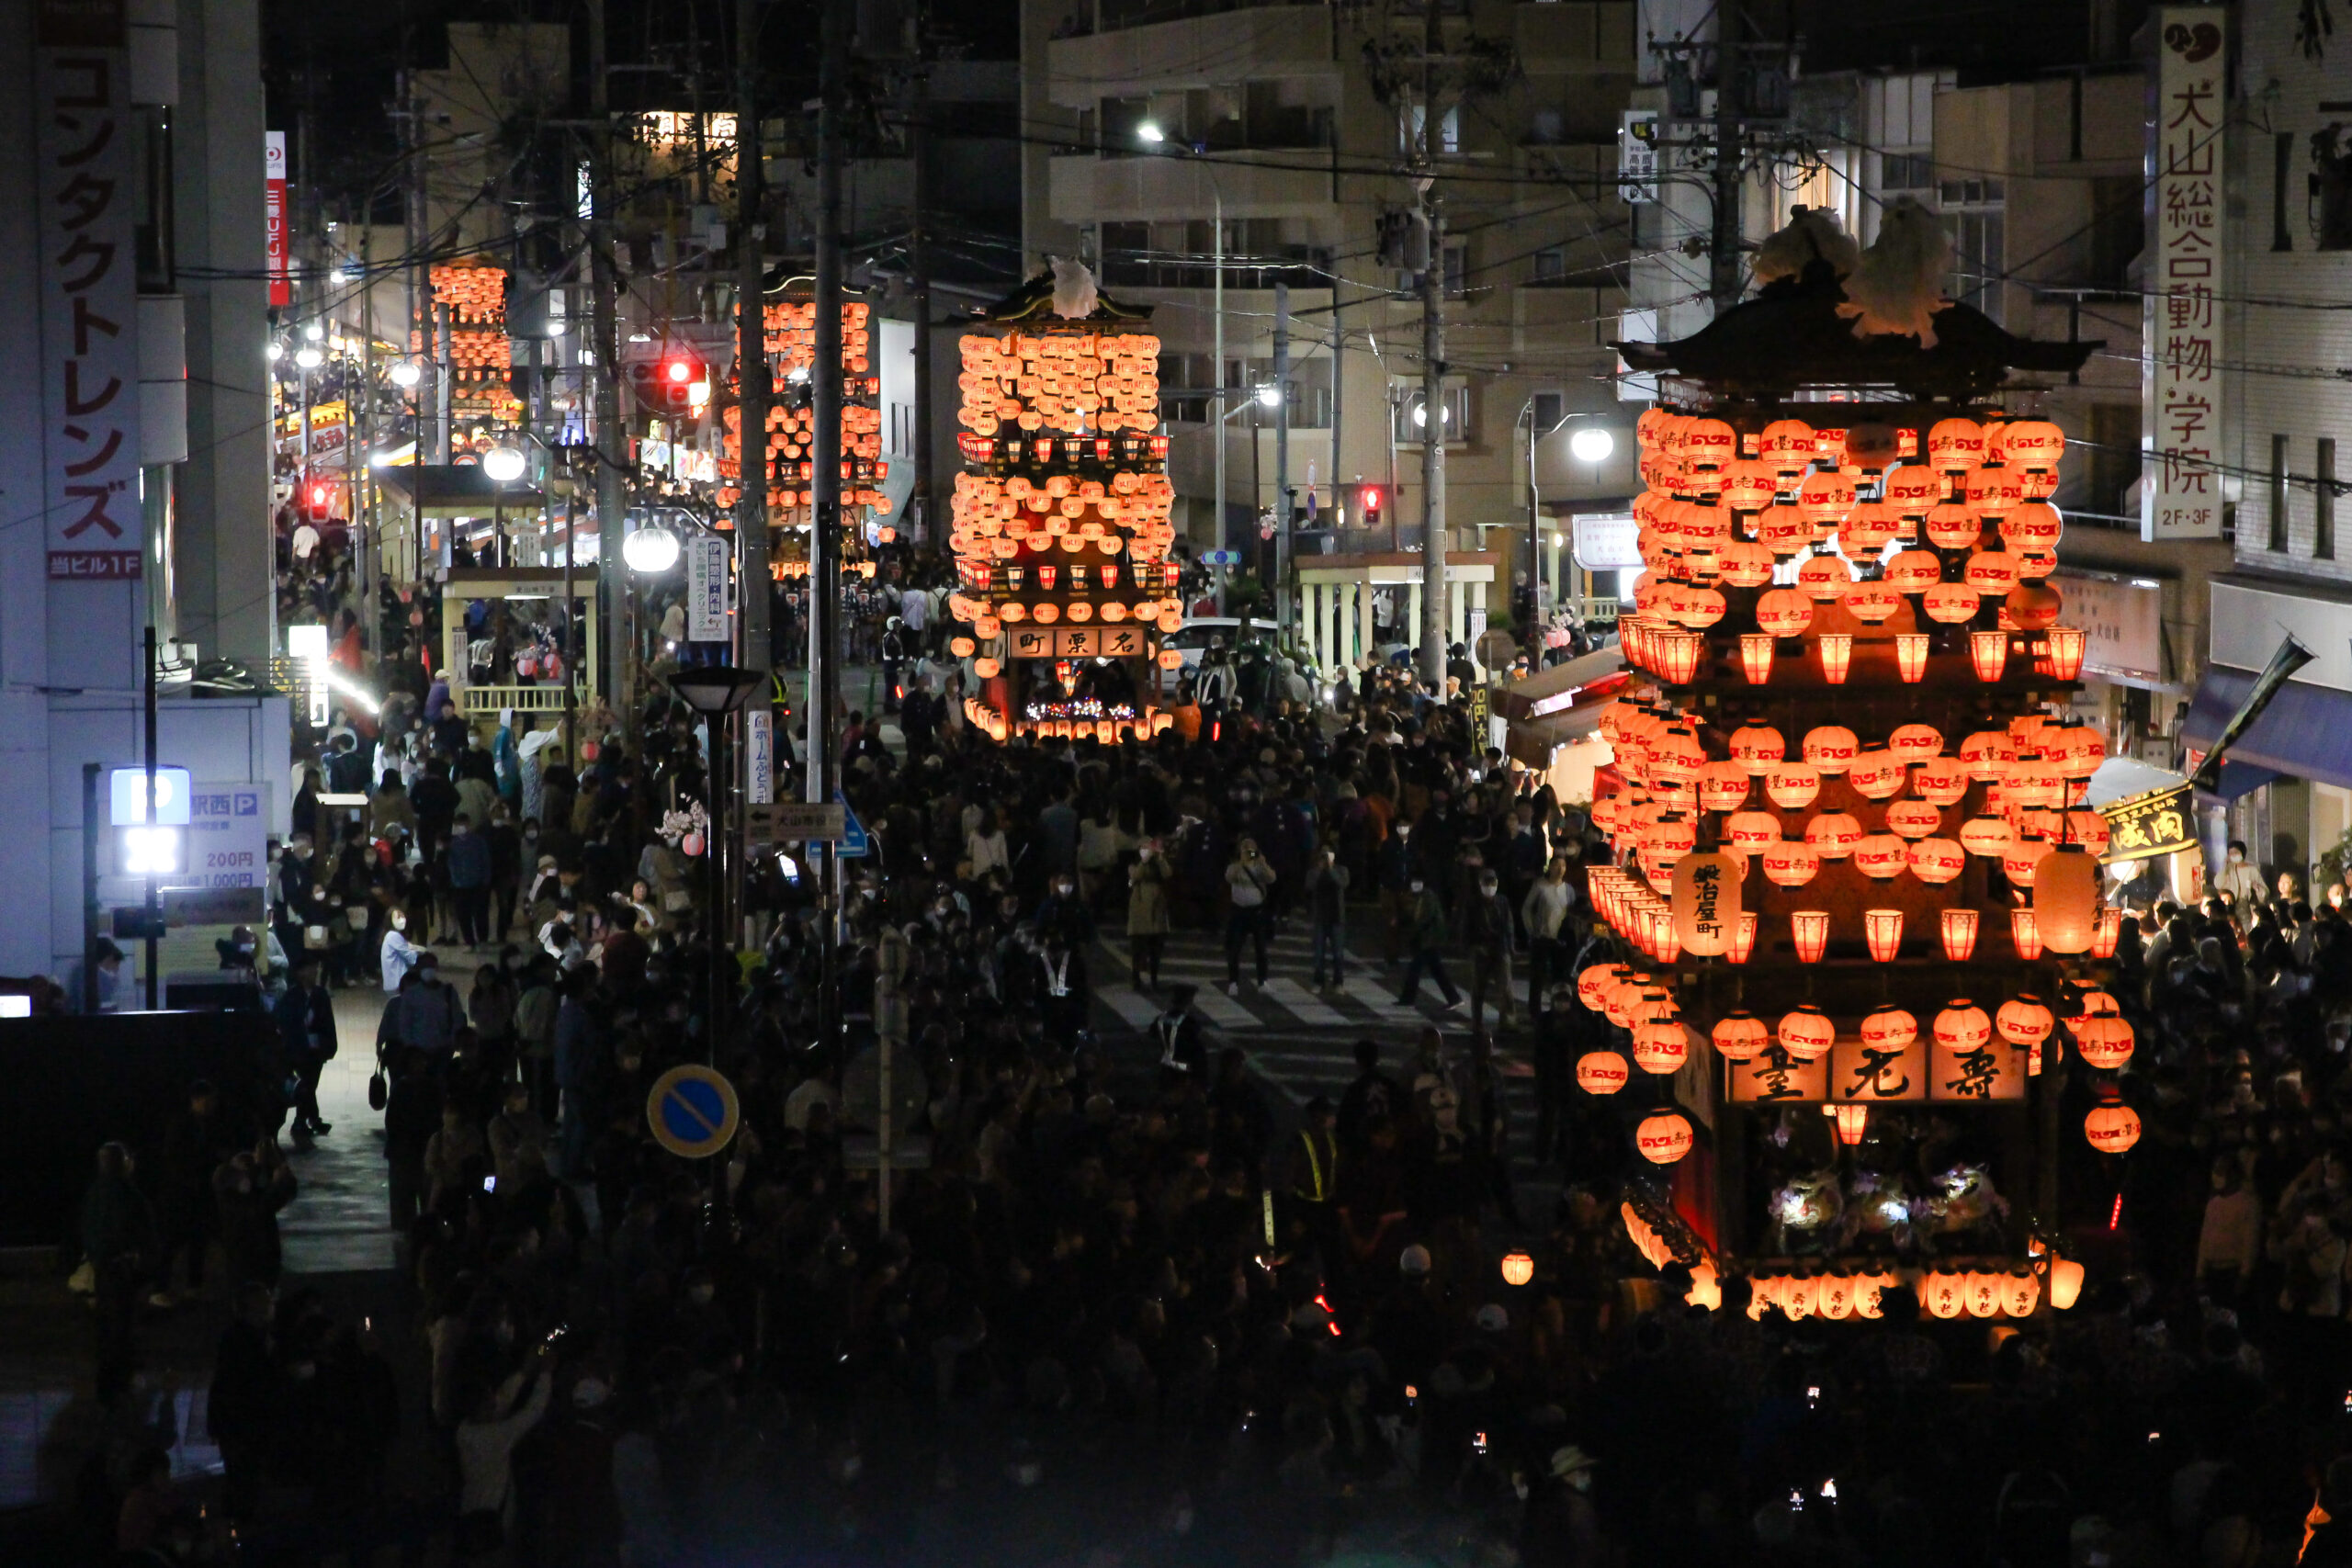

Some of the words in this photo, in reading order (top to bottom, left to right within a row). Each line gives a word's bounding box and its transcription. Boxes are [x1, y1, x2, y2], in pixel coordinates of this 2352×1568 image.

[54, 58, 127, 540] コンタクトレンズ
[2165, 79, 2215, 495] 犬山総合動物学院
[51, 555, 140, 576] 当ビル1F
[130, 775, 173, 822] P
[207, 852, 254, 867] 200円
[1693, 864, 1724, 939] 鍛冶屋町
